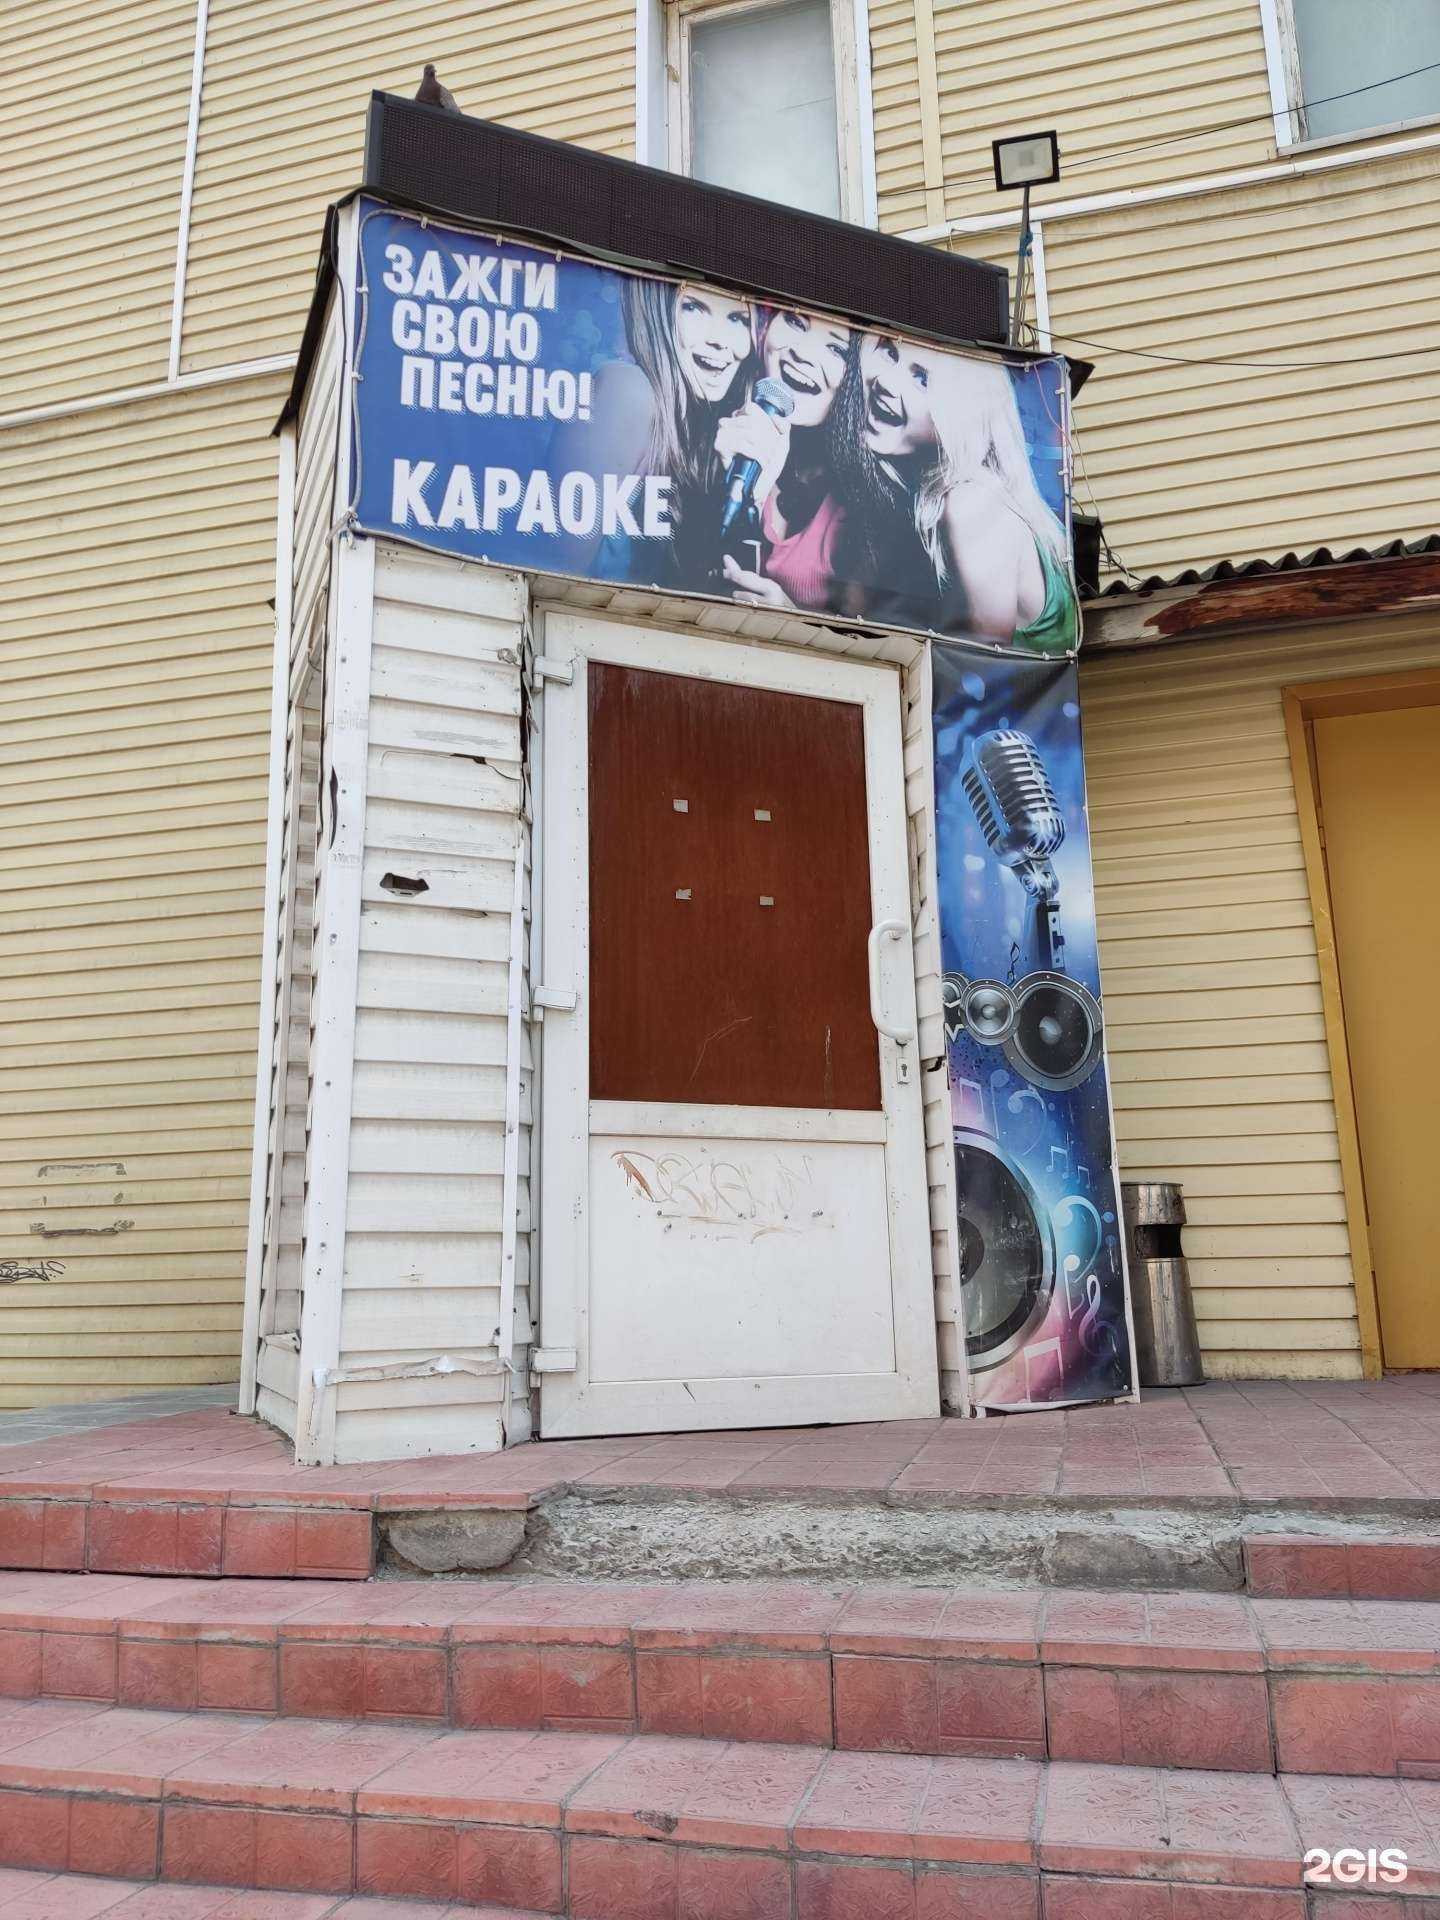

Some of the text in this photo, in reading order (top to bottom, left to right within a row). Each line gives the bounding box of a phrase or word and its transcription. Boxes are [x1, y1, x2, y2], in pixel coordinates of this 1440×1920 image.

[382, 244, 557, 310] ЗАЖГИ
[391, 300, 540, 362] СВОЮ
[400, 355, 592, 421] ПЕСНЮ!
[391, 458, 674, 538] КАРАОКЕ
